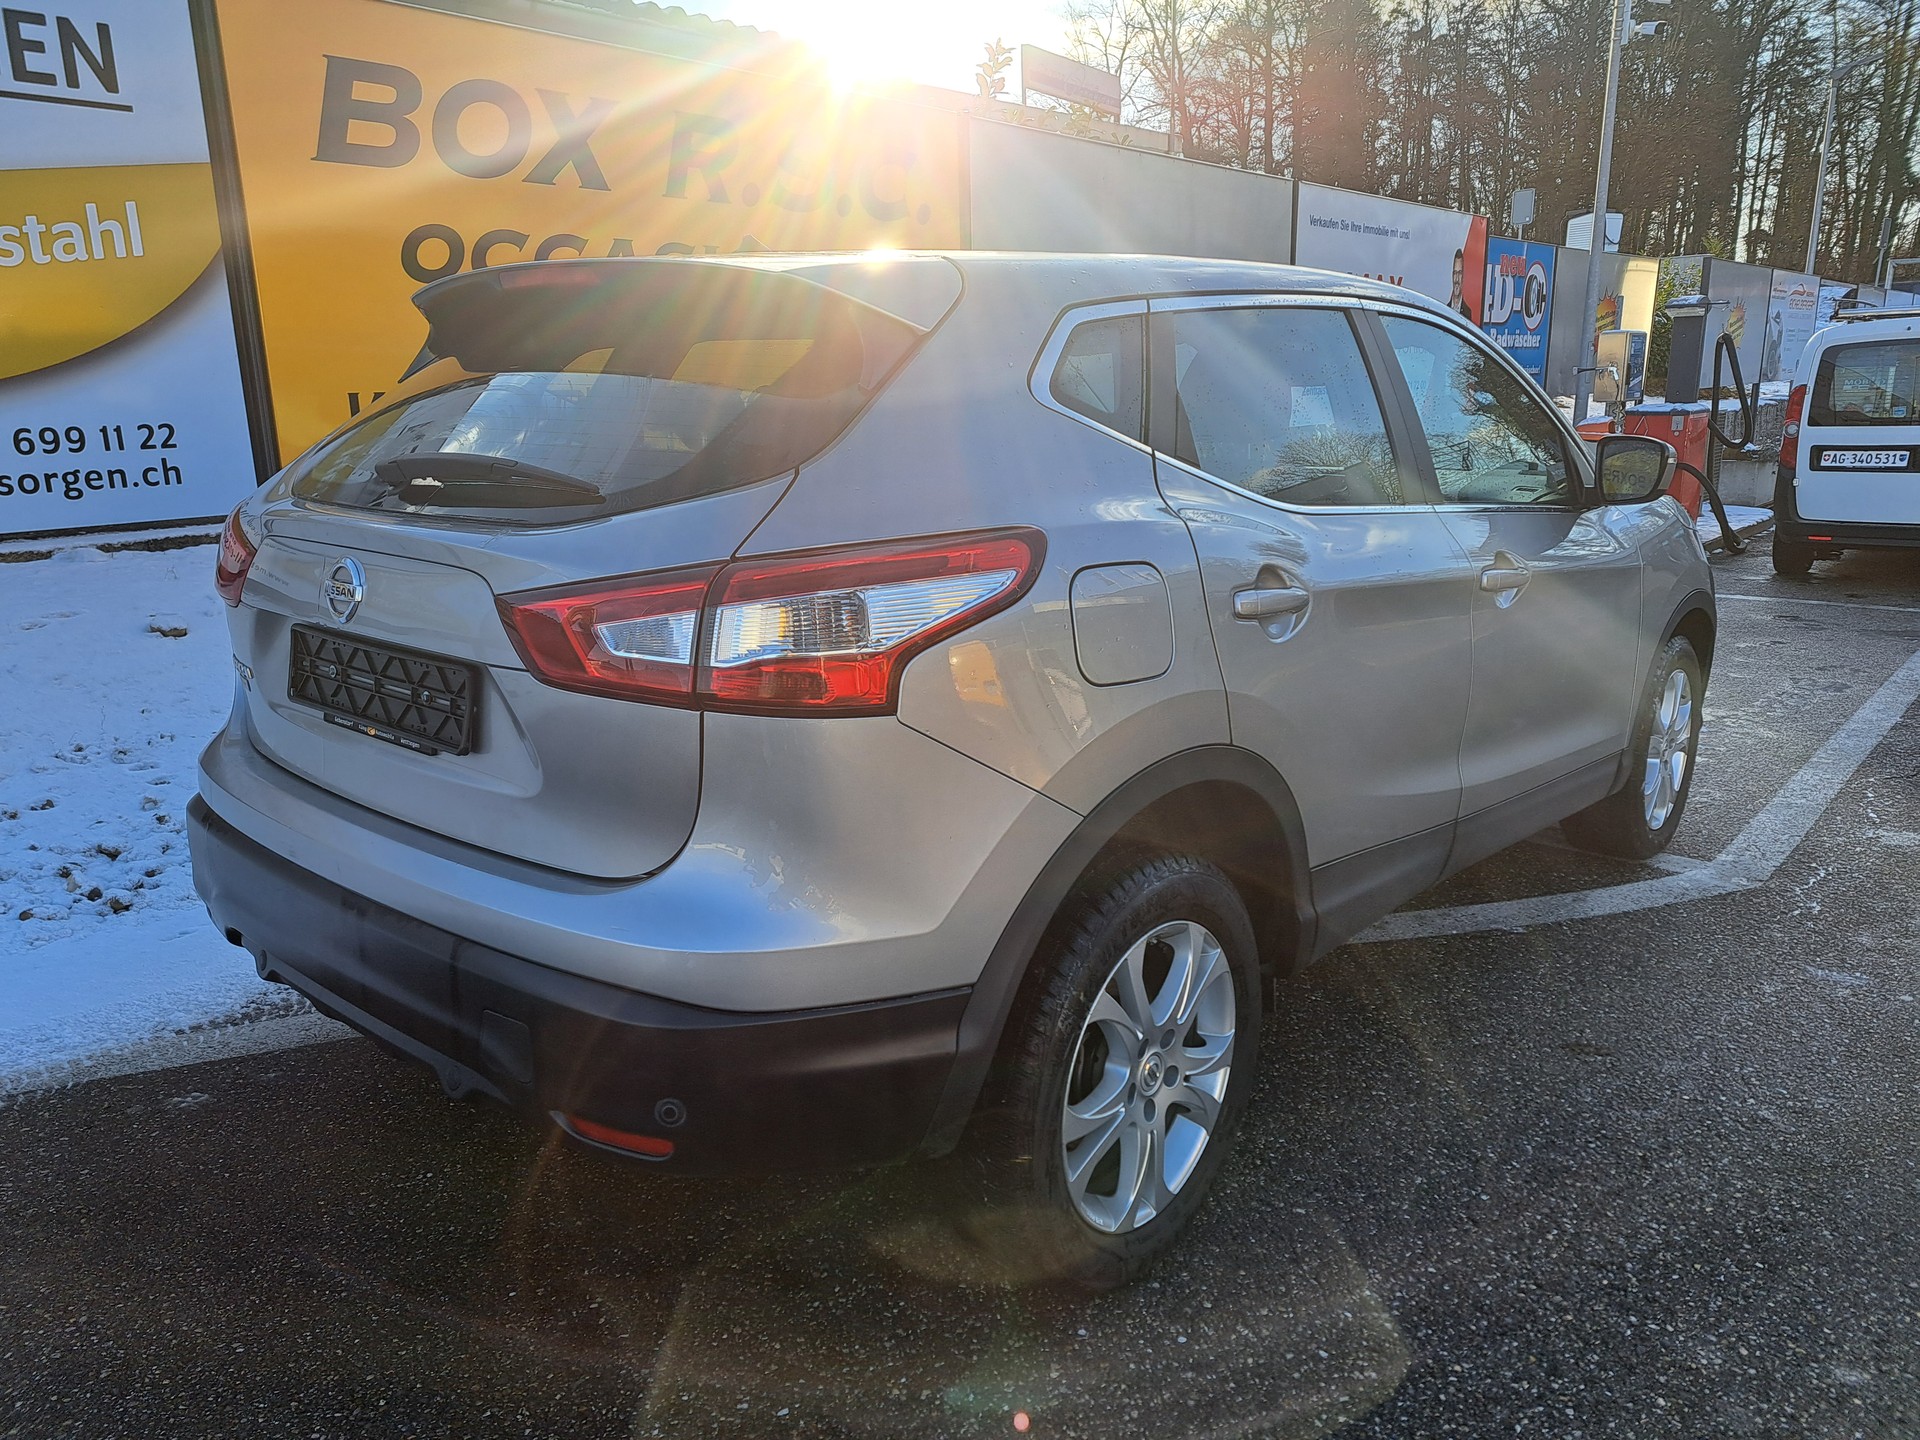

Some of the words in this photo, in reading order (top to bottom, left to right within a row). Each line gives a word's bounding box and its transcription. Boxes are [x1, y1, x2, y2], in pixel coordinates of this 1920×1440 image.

[310, 53, 612, 192] BOX
[1309, 214, 1340, 230] Verkaufen
[1340, 219, 1350, 232] Sie
[1351, 221, 1362, 233] Ihre
[1363, 223, 1389, 237] Immobilie
[1390, 228, 1399, 238] mit
[1400, 229, 1411, 239] uns!
[1500, 254, 1526, 276] neu
[1490, 328, 1541, 348] Radwäscher
[13, 426, 87, 456] 699
[99, 425, 126, 452] 11
[137, 423, 178, 451] 22
[0, 458, 183, 501] sorgen.ch
